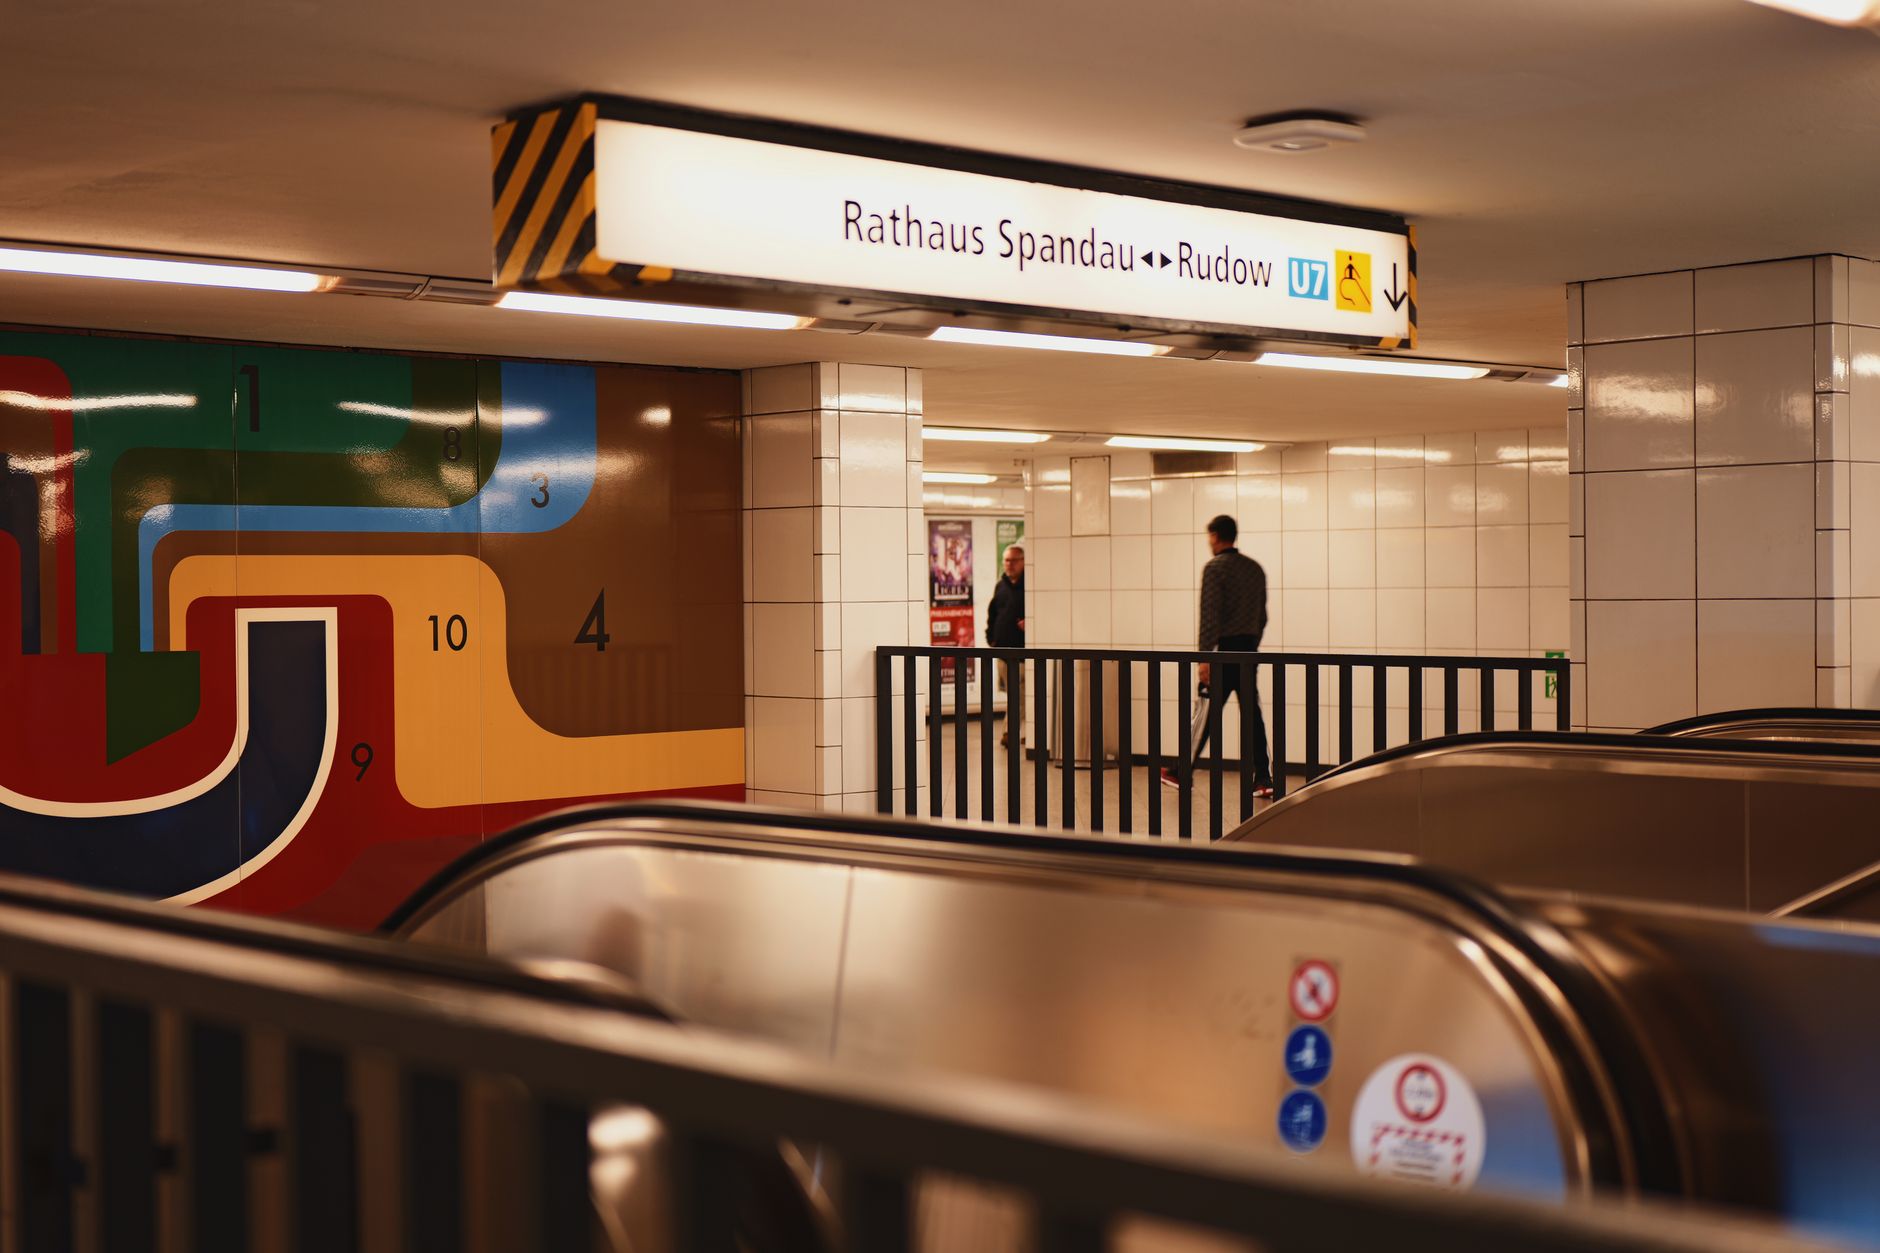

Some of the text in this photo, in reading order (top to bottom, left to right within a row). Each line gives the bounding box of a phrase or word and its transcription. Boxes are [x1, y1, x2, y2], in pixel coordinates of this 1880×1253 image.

[844, 199, 1327, 297] Rathaus Spandau Rudow U7
[239, 363, 261, 433] 1
[442, 426, 463, 462] 8
[529, 471, 551, 509] 3
[427, 614, 469, 652] 10
[572, 586, 611, 653] 4
[350, 742, 374, 782] 9
